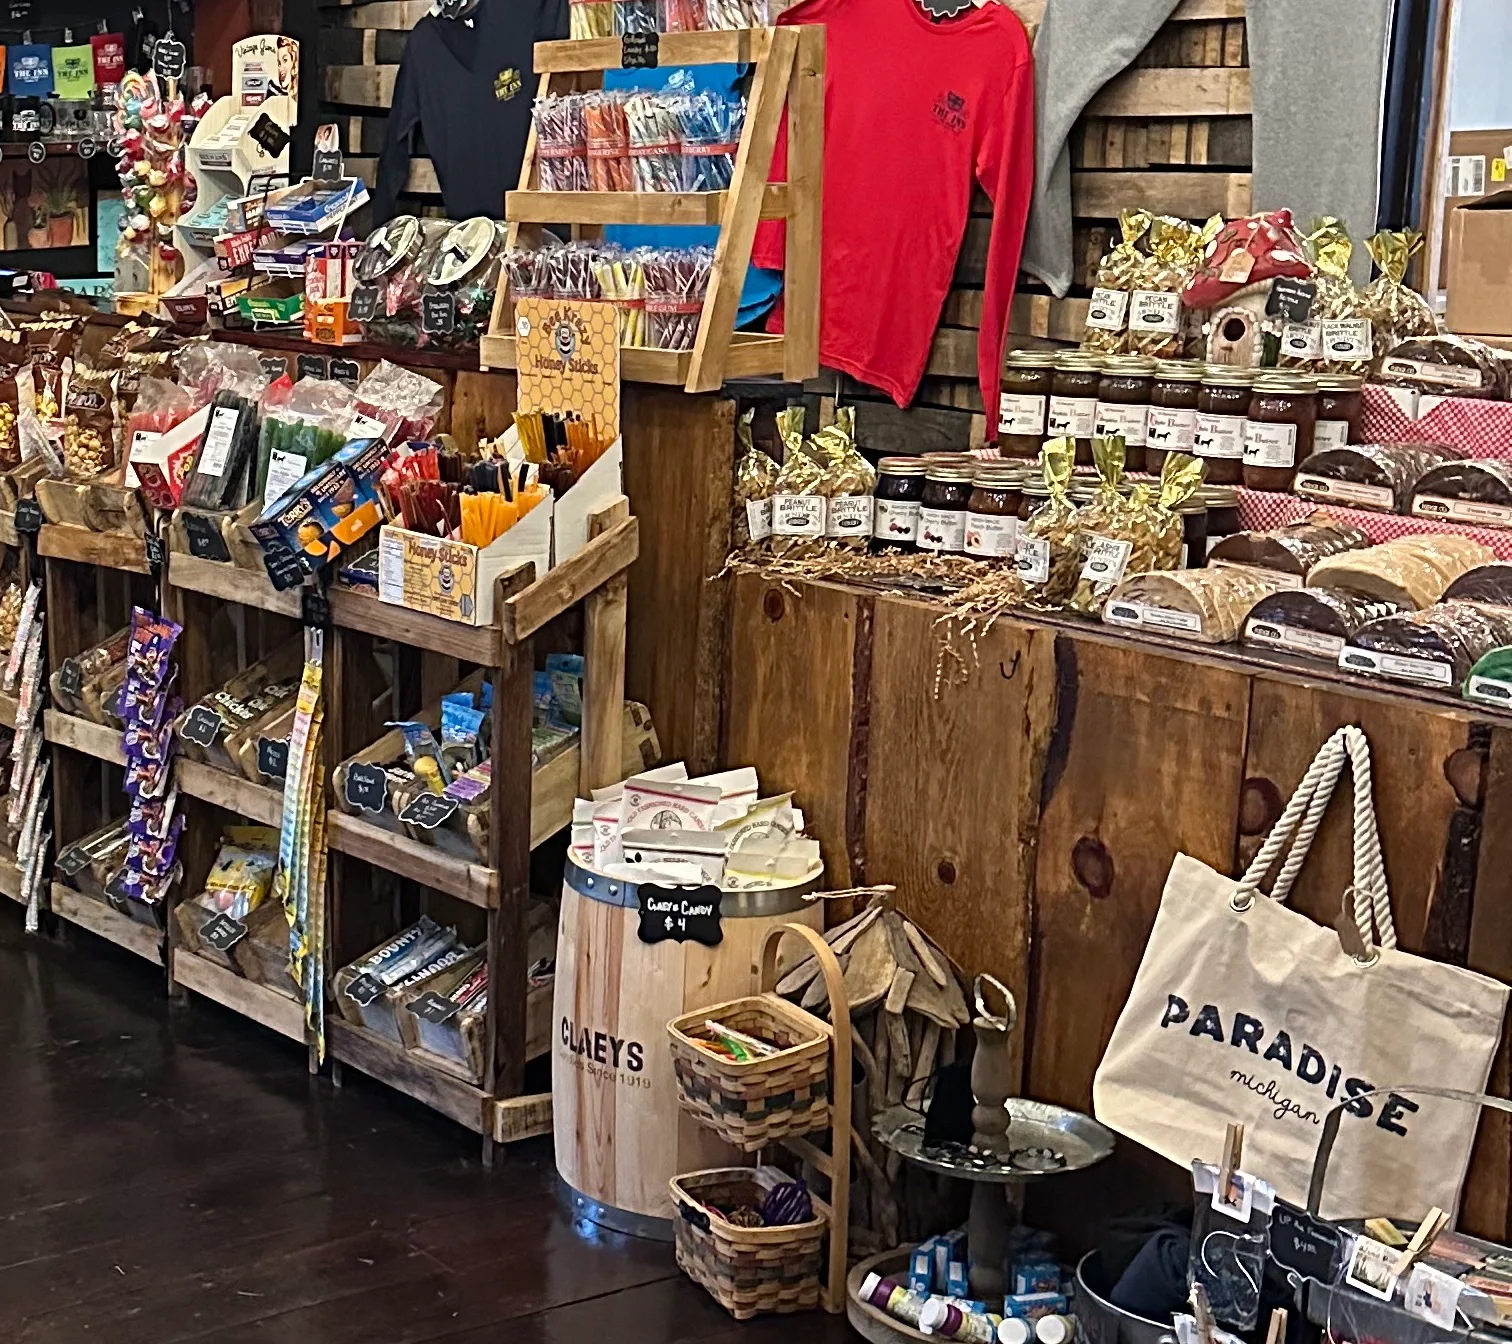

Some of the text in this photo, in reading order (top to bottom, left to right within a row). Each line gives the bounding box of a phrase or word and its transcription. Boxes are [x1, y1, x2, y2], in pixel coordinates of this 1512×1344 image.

[97, 56, 110, 65] THE
[14, 66, 30, 77] THE
[57, 67, 72, 77] THE
[1138, 301, 1173, 310] BRITTLE
[1325, 330, 1358, 338] BRITTLE
[535, 354, 598, 374] Honey Sticks
[784, 498, 811, 506] PEANUT
[780, 505, 817, 513] BRITTLE
[832, 505, 868, 514] BRITTLE
[409, 542, 468, 567] Honey Sticks
[369, 926, 424, 965] BOUNTY
[561, 1016, 643, 1072] CLAEYS
[1160, 994, 1419, 1136] PARADISE
[587, 1062, 651, 1089] Since 1919
[1230, 1068, 1320, 1125] michigan
